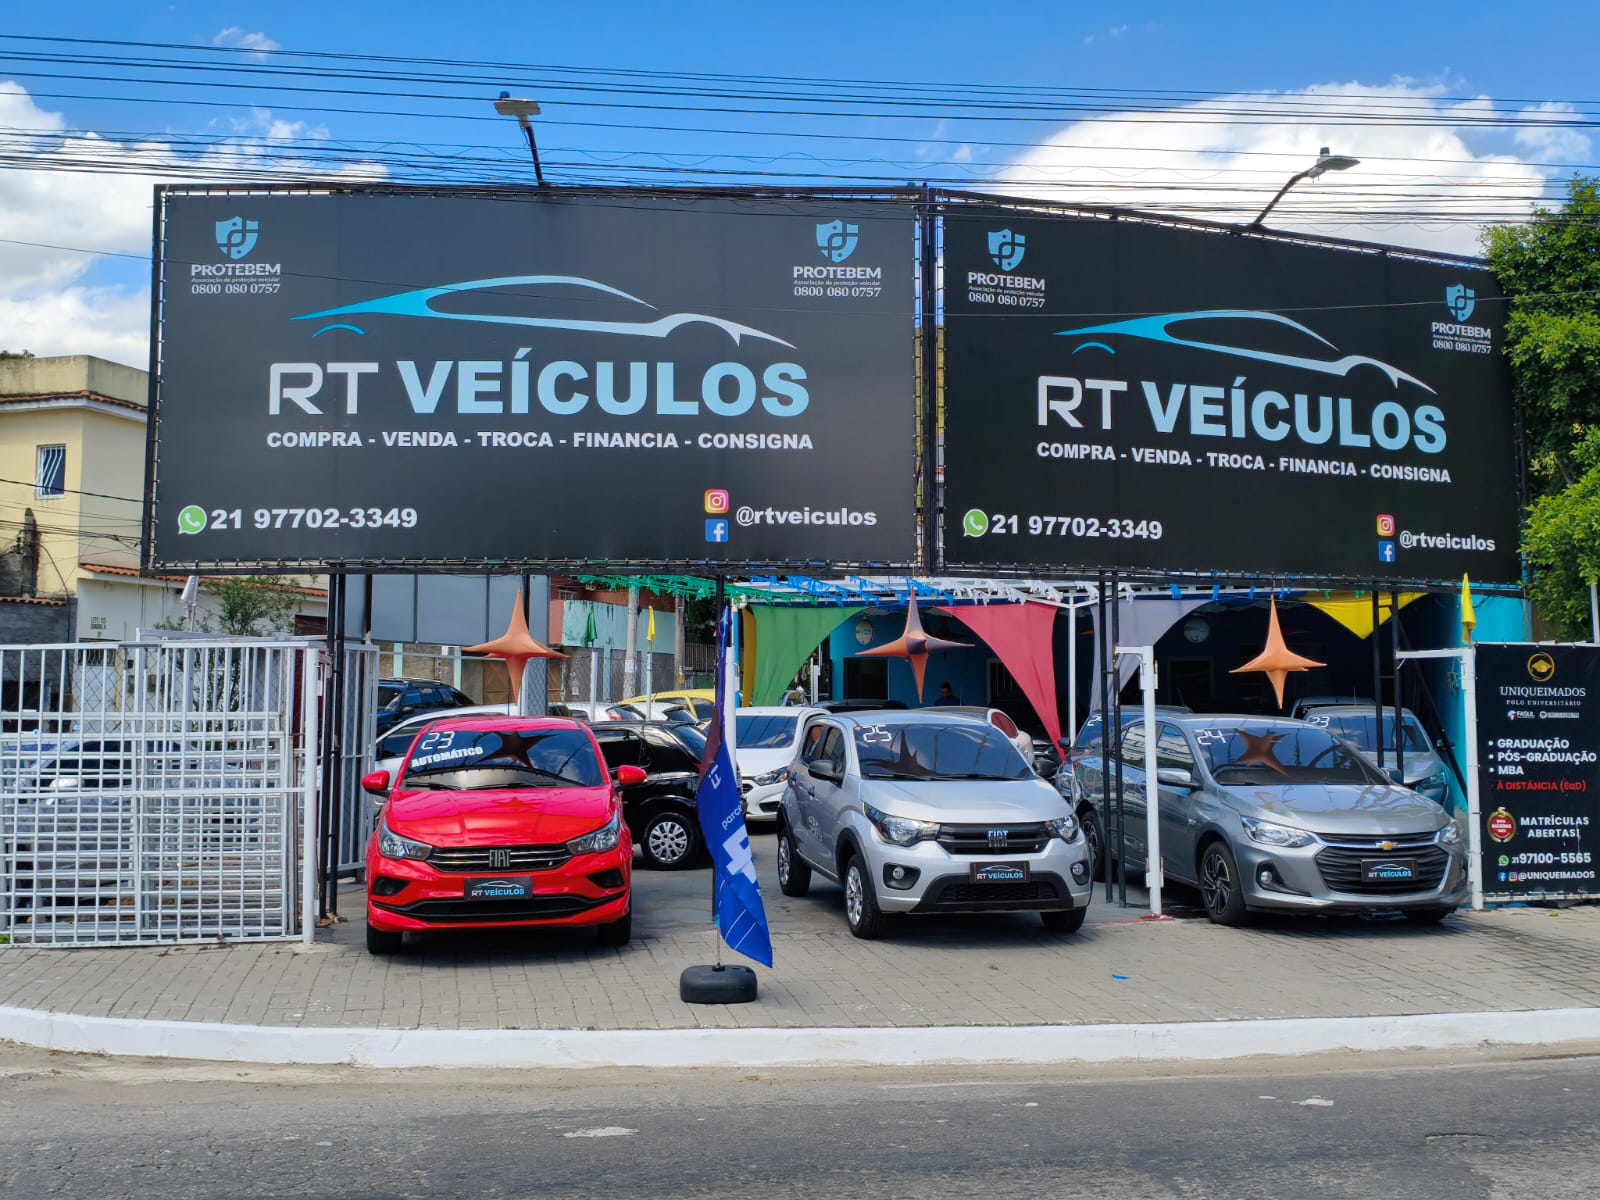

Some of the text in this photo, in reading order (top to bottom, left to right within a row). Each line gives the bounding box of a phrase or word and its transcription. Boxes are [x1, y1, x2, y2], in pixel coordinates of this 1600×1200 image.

[192, 264, 280, 275] PROTEBEM
[794, 267, 881, 278] PROTEBEM
[192, 283, 280, 294] 0800 080 0757
[968, 272, 1045, 290] PROTEBEM
[794, 286, 881, 298] 0800 080 0757
[968, 292, 1045, 308] 0800 080 0757
[1432, 322, 1491, 338] PROTEBEM
[1433, 340, 1492, 354] 0800 080 0757
[269, 347, 809, 416] RT VEÍCULOS
[1038, 376, 1447, 454] RT VEÍCULOS
[267, 432, 362, 447] COMPRA
[382, 432, 458, 446] VENDA
[478, 432, 553, 447] TROCA
[574, 433, 678, 447] FINANCIA
[698, 434, 813, 449] CONSIGNA
[1037, 442, 1116, 460] COMPRA
[1132, 448, 1192, 465] VENDA
[1207, 453, 1265, 469] TROCA
[1280, 458, 1357, 476] FINANCIA
[1371, 464, 1451, 482] CONSIGNA
[211, 508, 417, 529] 21 97702-3349
[736, 506, 876, 526] @rtveiculos
[992, 515, 1162, 539] 21 97702-3349
[1400, 531, 1495, 551] @rtveiculos
[1500, 686, 1586, 697] UNIQUEIMADOS
[421, 731, 455, 750] 23
[862, 725, 892, 742] 25
[1196, 730, 1227, 745] 24
[1498, 737, 1569, 751] GRADUAÇÃO
[411, 747, 483, 767] AUTOMÁTICO
[1498, 750, 1597, 764] PÓS-GRADUAÇÃO
[1498, 766, 1524, 775] MBA
[1520, 815, 1589, 825] MATRÍCULAS
[988, 830, 1008, 848] FIAT
[489, 849, 511, 868] FIAT
[1518, 871, 1595, 881] @UNIQUEIMADOS
[484, 888, 525, 896] VEÍCULOS
